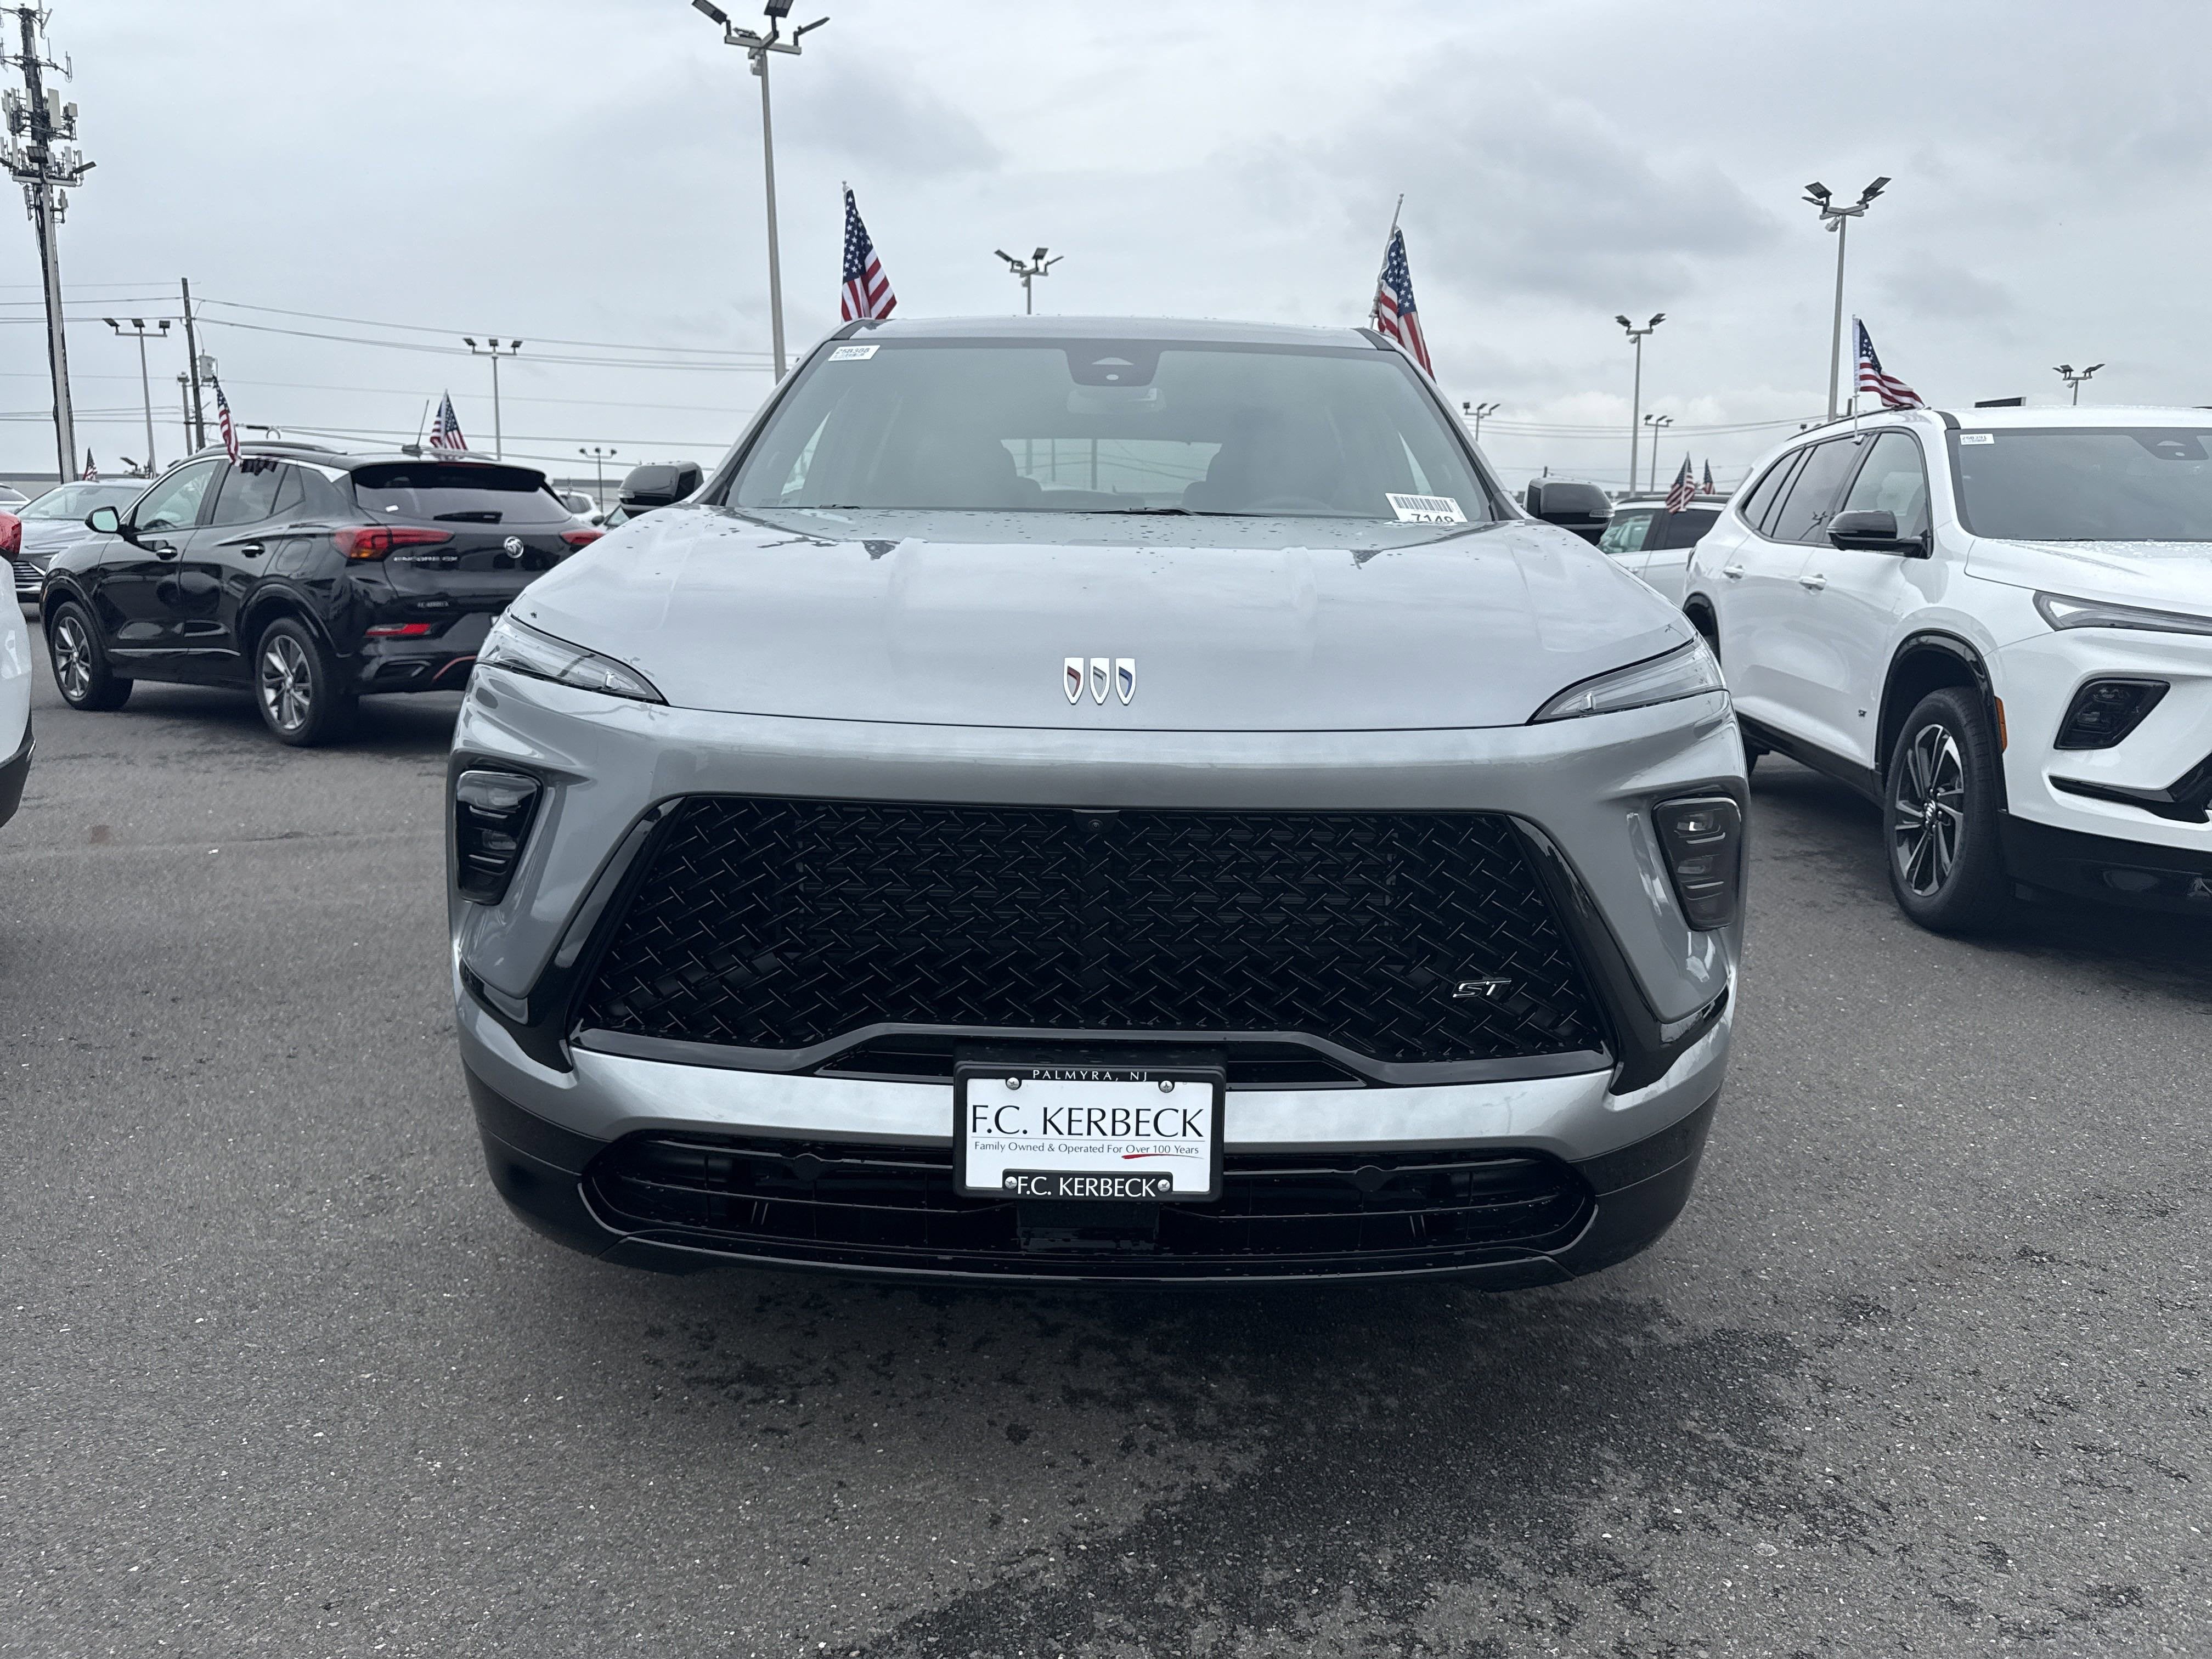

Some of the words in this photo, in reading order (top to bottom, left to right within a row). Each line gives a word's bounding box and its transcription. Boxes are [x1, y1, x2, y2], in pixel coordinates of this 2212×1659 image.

[1452, 978, 1513, 998] ST
[1032, 1069, 1119, 1082] PALMYRA,
[1130, 1071, 1148, 1082] NJ
[972, 1104, 1028, 1135] F.C.
[1043, 1107, 1204, 1137] KERBECK
[975, 1141, 1006, 1152] Family
[1008, 1142, 1044, 1152] Owned
[1047, 1143, 1055, 1152] &
[1058, 1143, 1104, 1154] Operated
[1107, 1144, 1123, 1153] For
[1126, 1144, 1150, 1154] Over
[1153, 1145, 1171, 1154] 100
[1174, 1145, 1199, 1154] Years
[1017, 1176, 1052, 1195] F.C.
[1059, 1177, 1156, 1197] KERBECK
